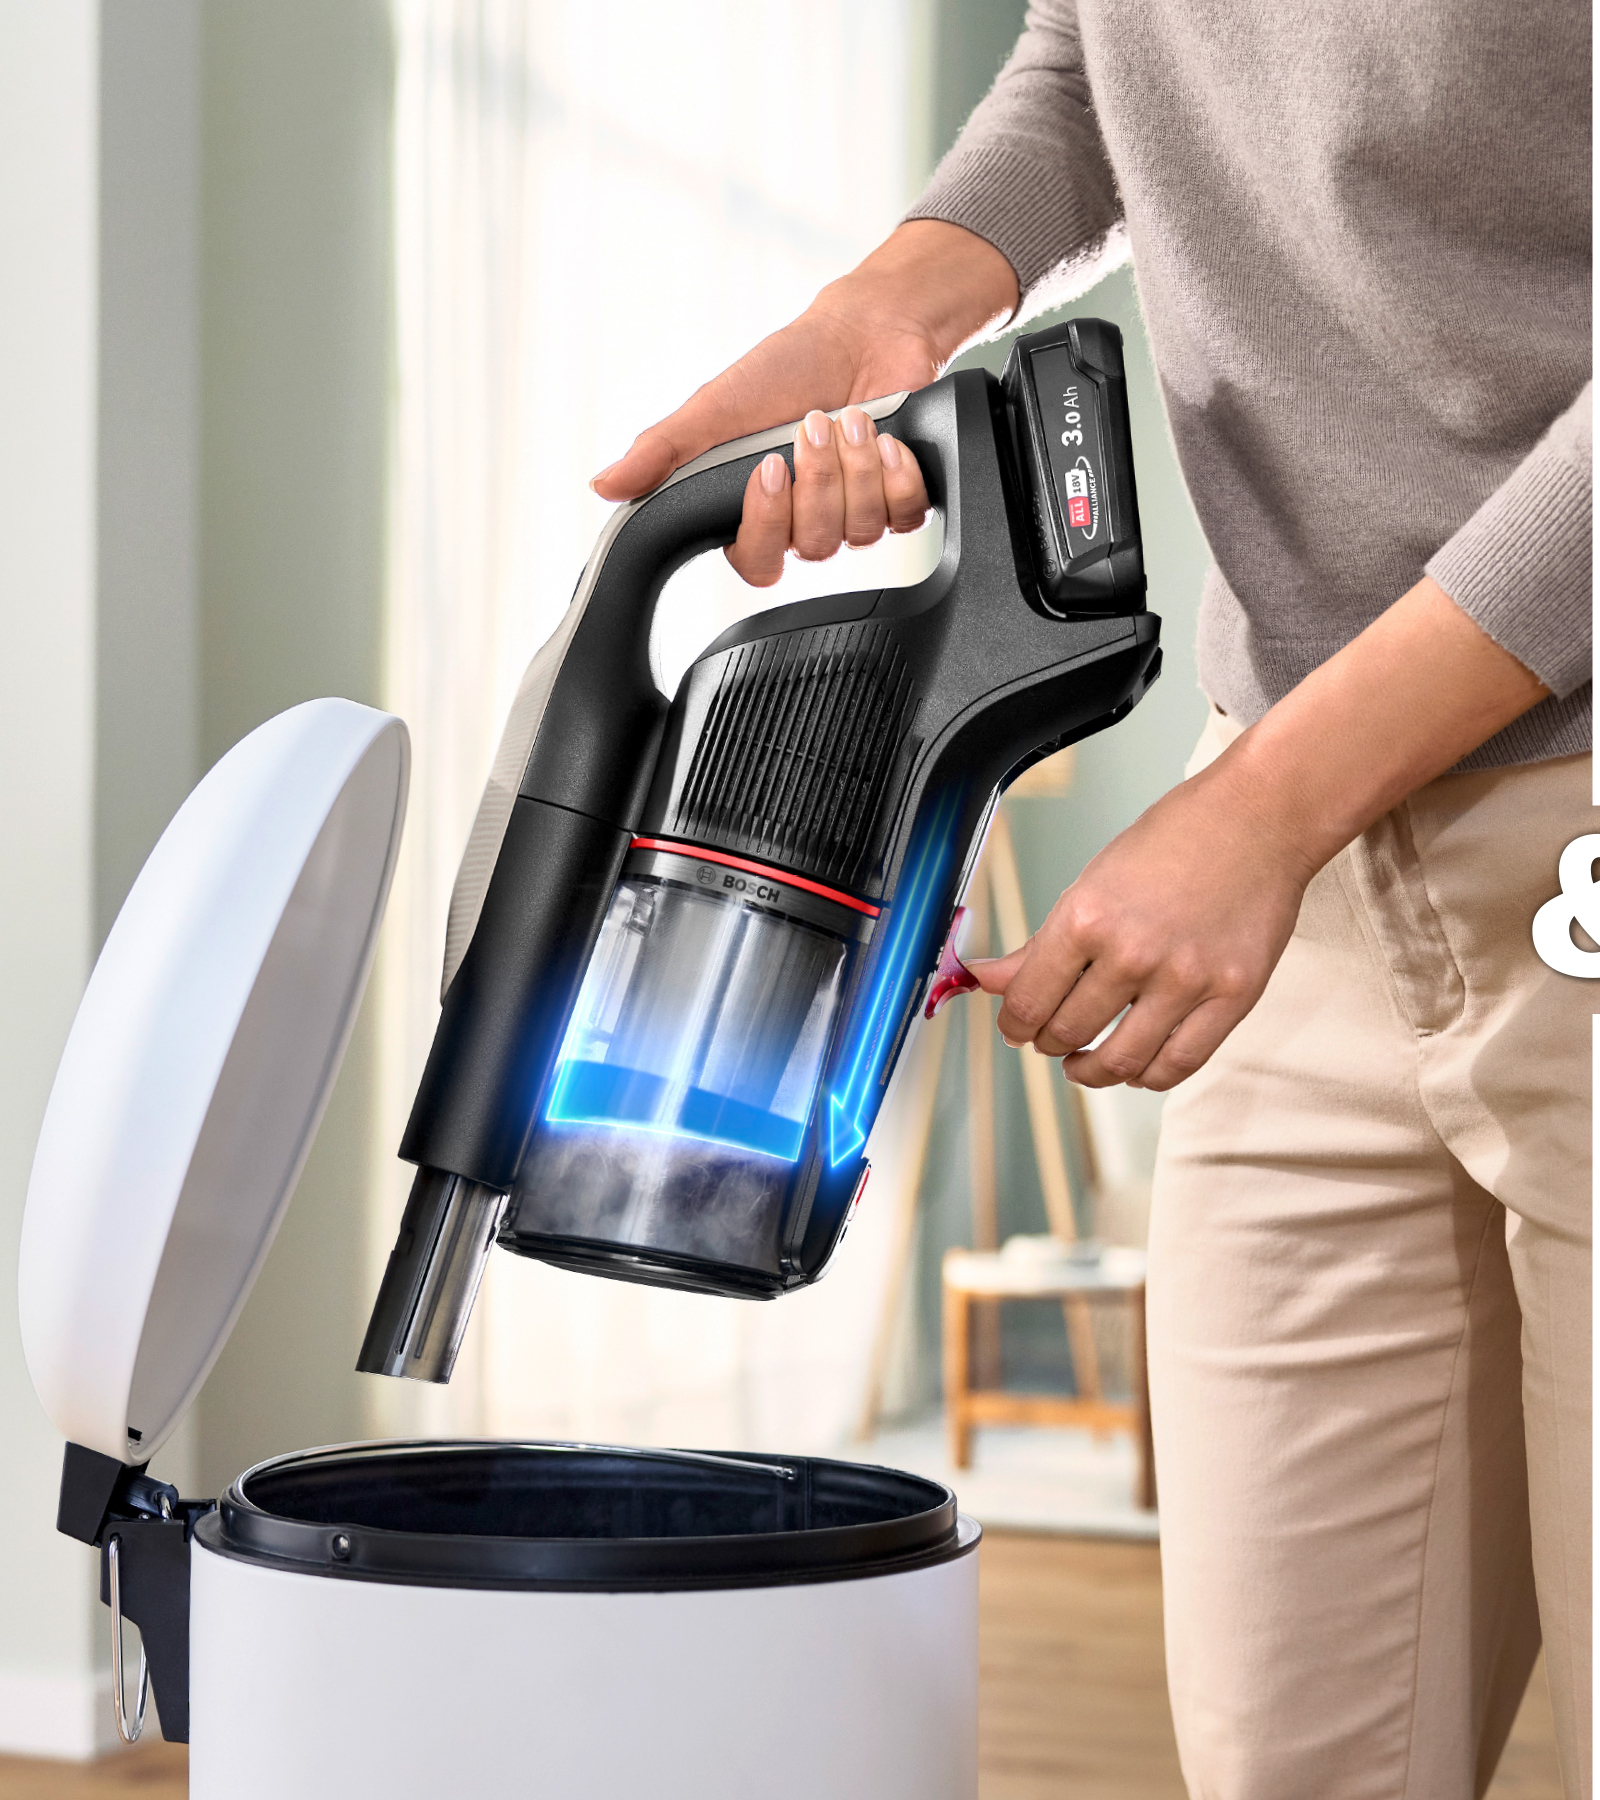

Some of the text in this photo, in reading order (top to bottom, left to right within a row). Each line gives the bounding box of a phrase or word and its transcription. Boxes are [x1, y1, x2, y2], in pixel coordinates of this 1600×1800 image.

[1061, 386, 1083, 446] 3.0 Ah
[1071, 475, 1081, 493] 18V
[1089, 478, 1099, 516] ALLIANCE
[1074, 500, 1085, 522] ALL
[722, 874, 781, 904] BOSCH
